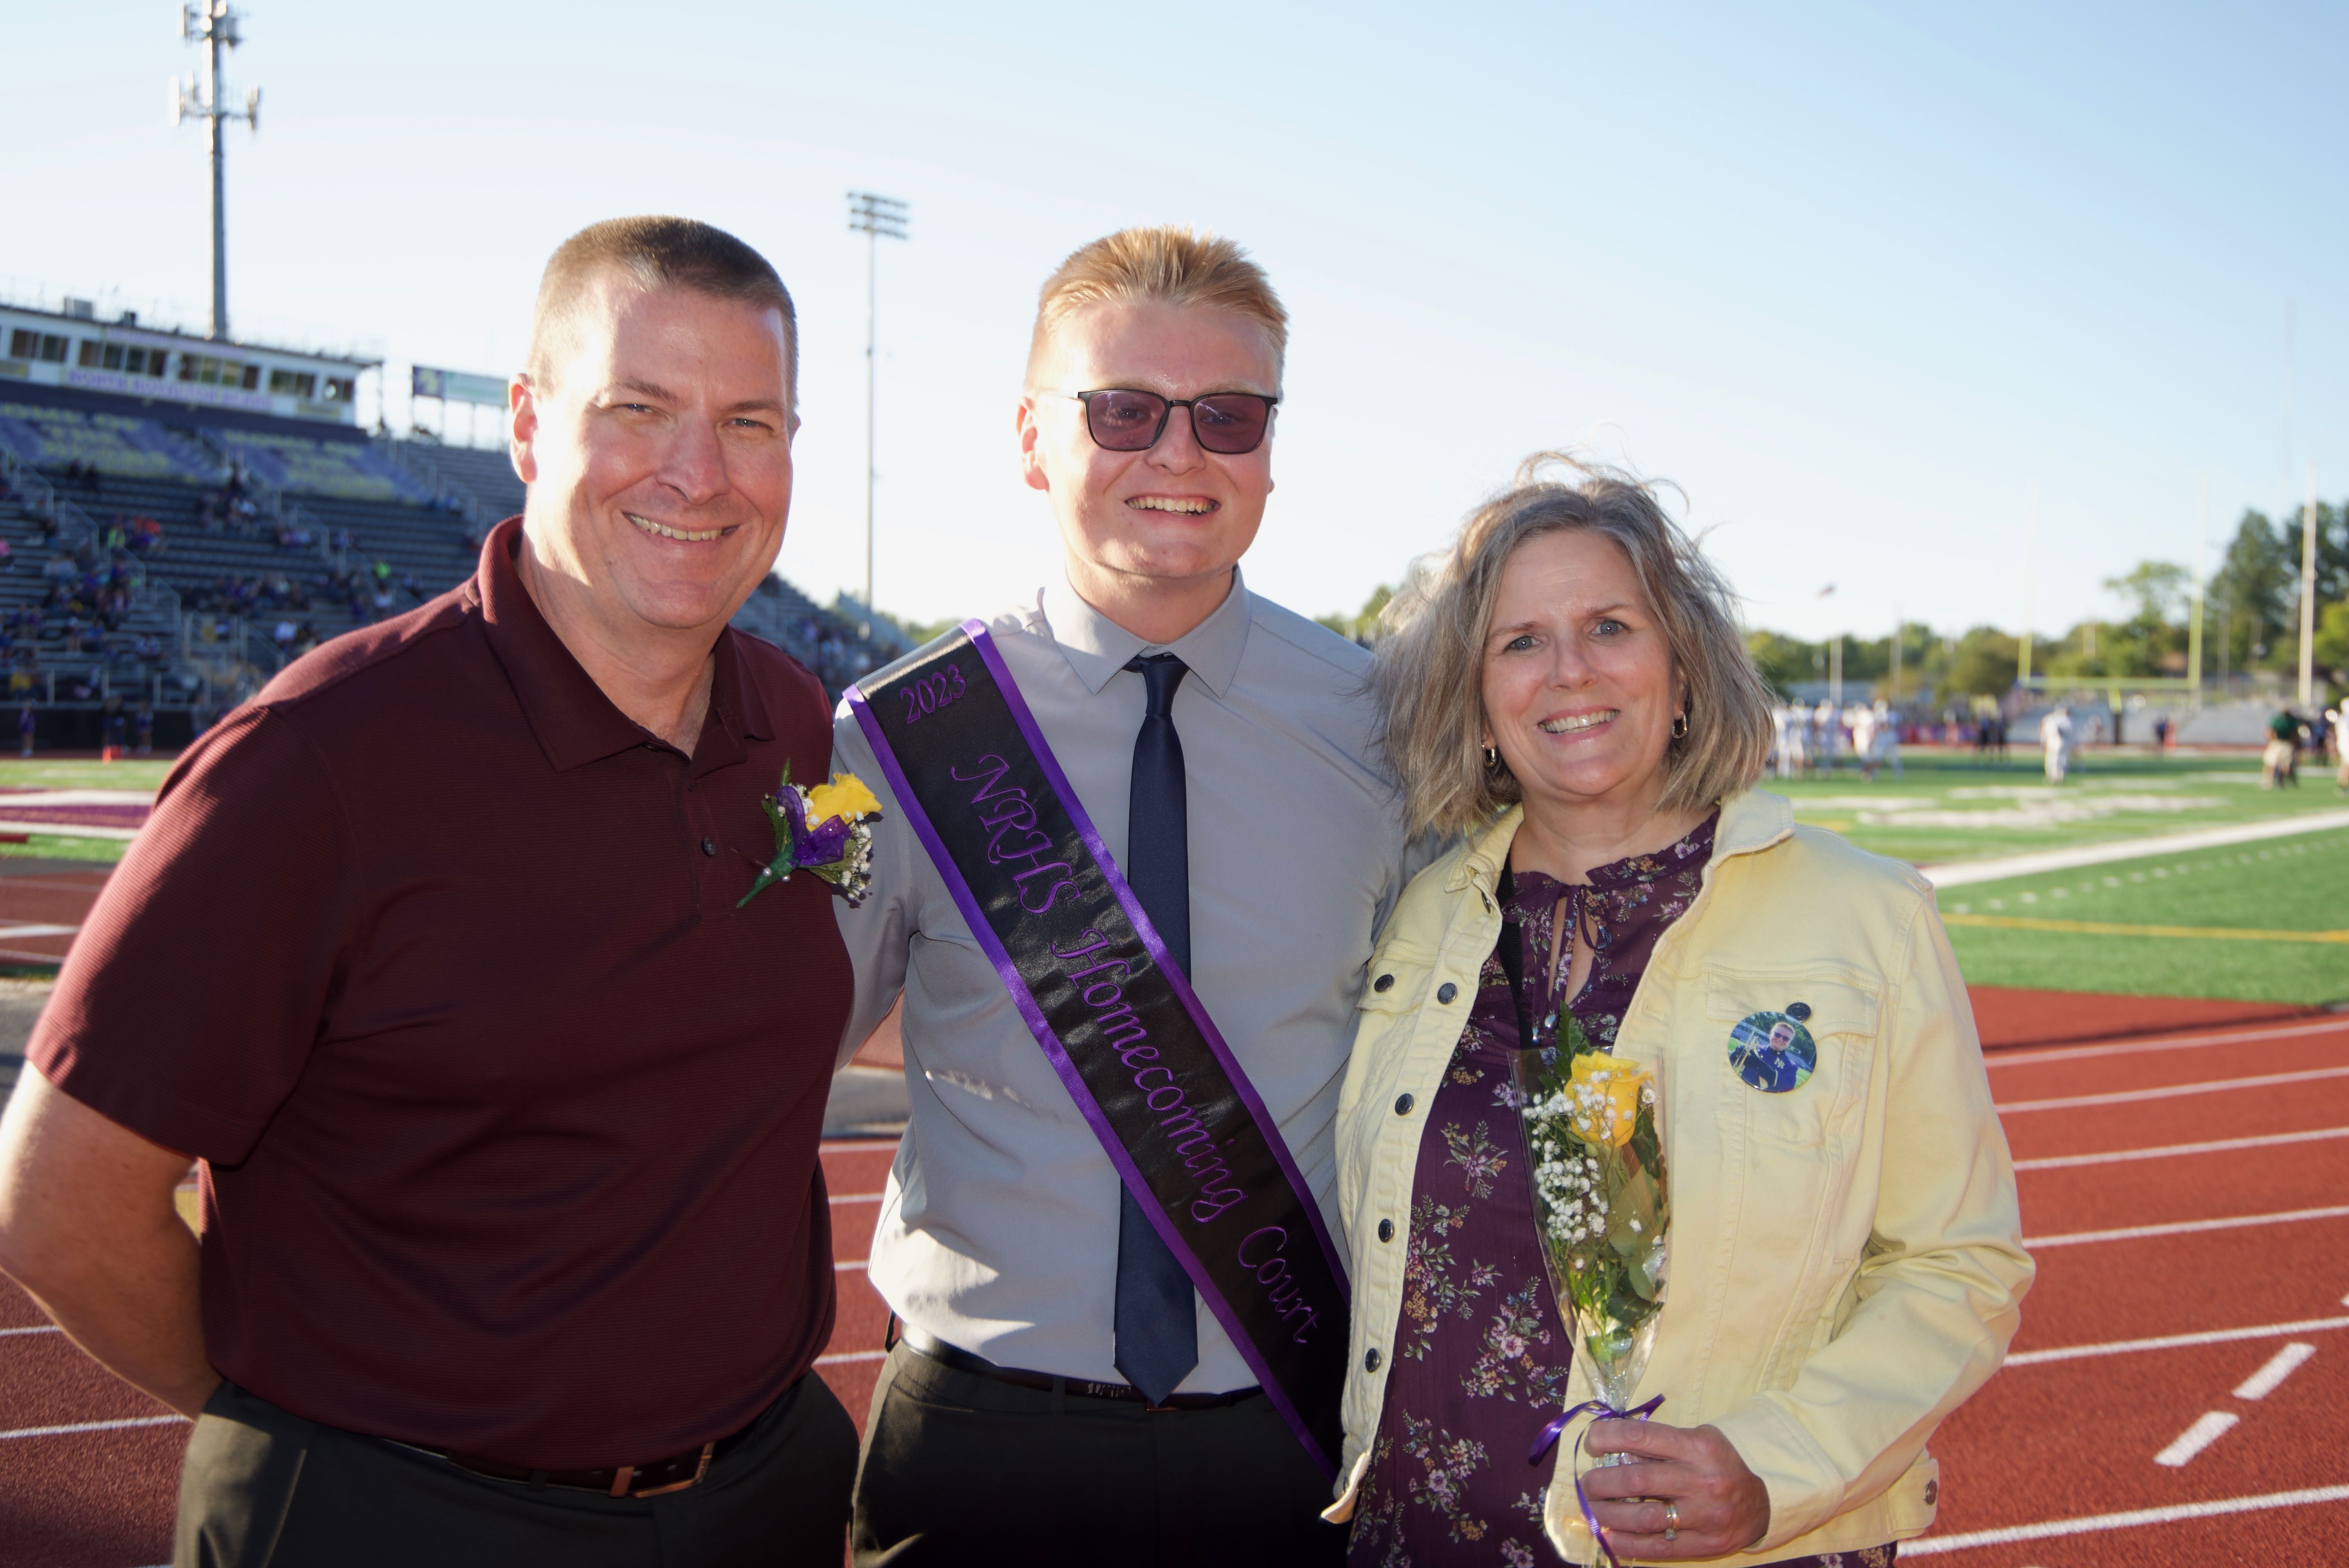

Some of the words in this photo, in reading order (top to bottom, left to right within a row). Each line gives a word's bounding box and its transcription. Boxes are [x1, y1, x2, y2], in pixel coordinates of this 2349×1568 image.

[900, 663, 966, 724] 2023
[950, 753, 1081, 914] NRHS
[1051, 928, 1248, 1222] Homecoming
[1238, 1226, 1319, 1343] Court
[1774, 1057, 1785, 1069] NR
